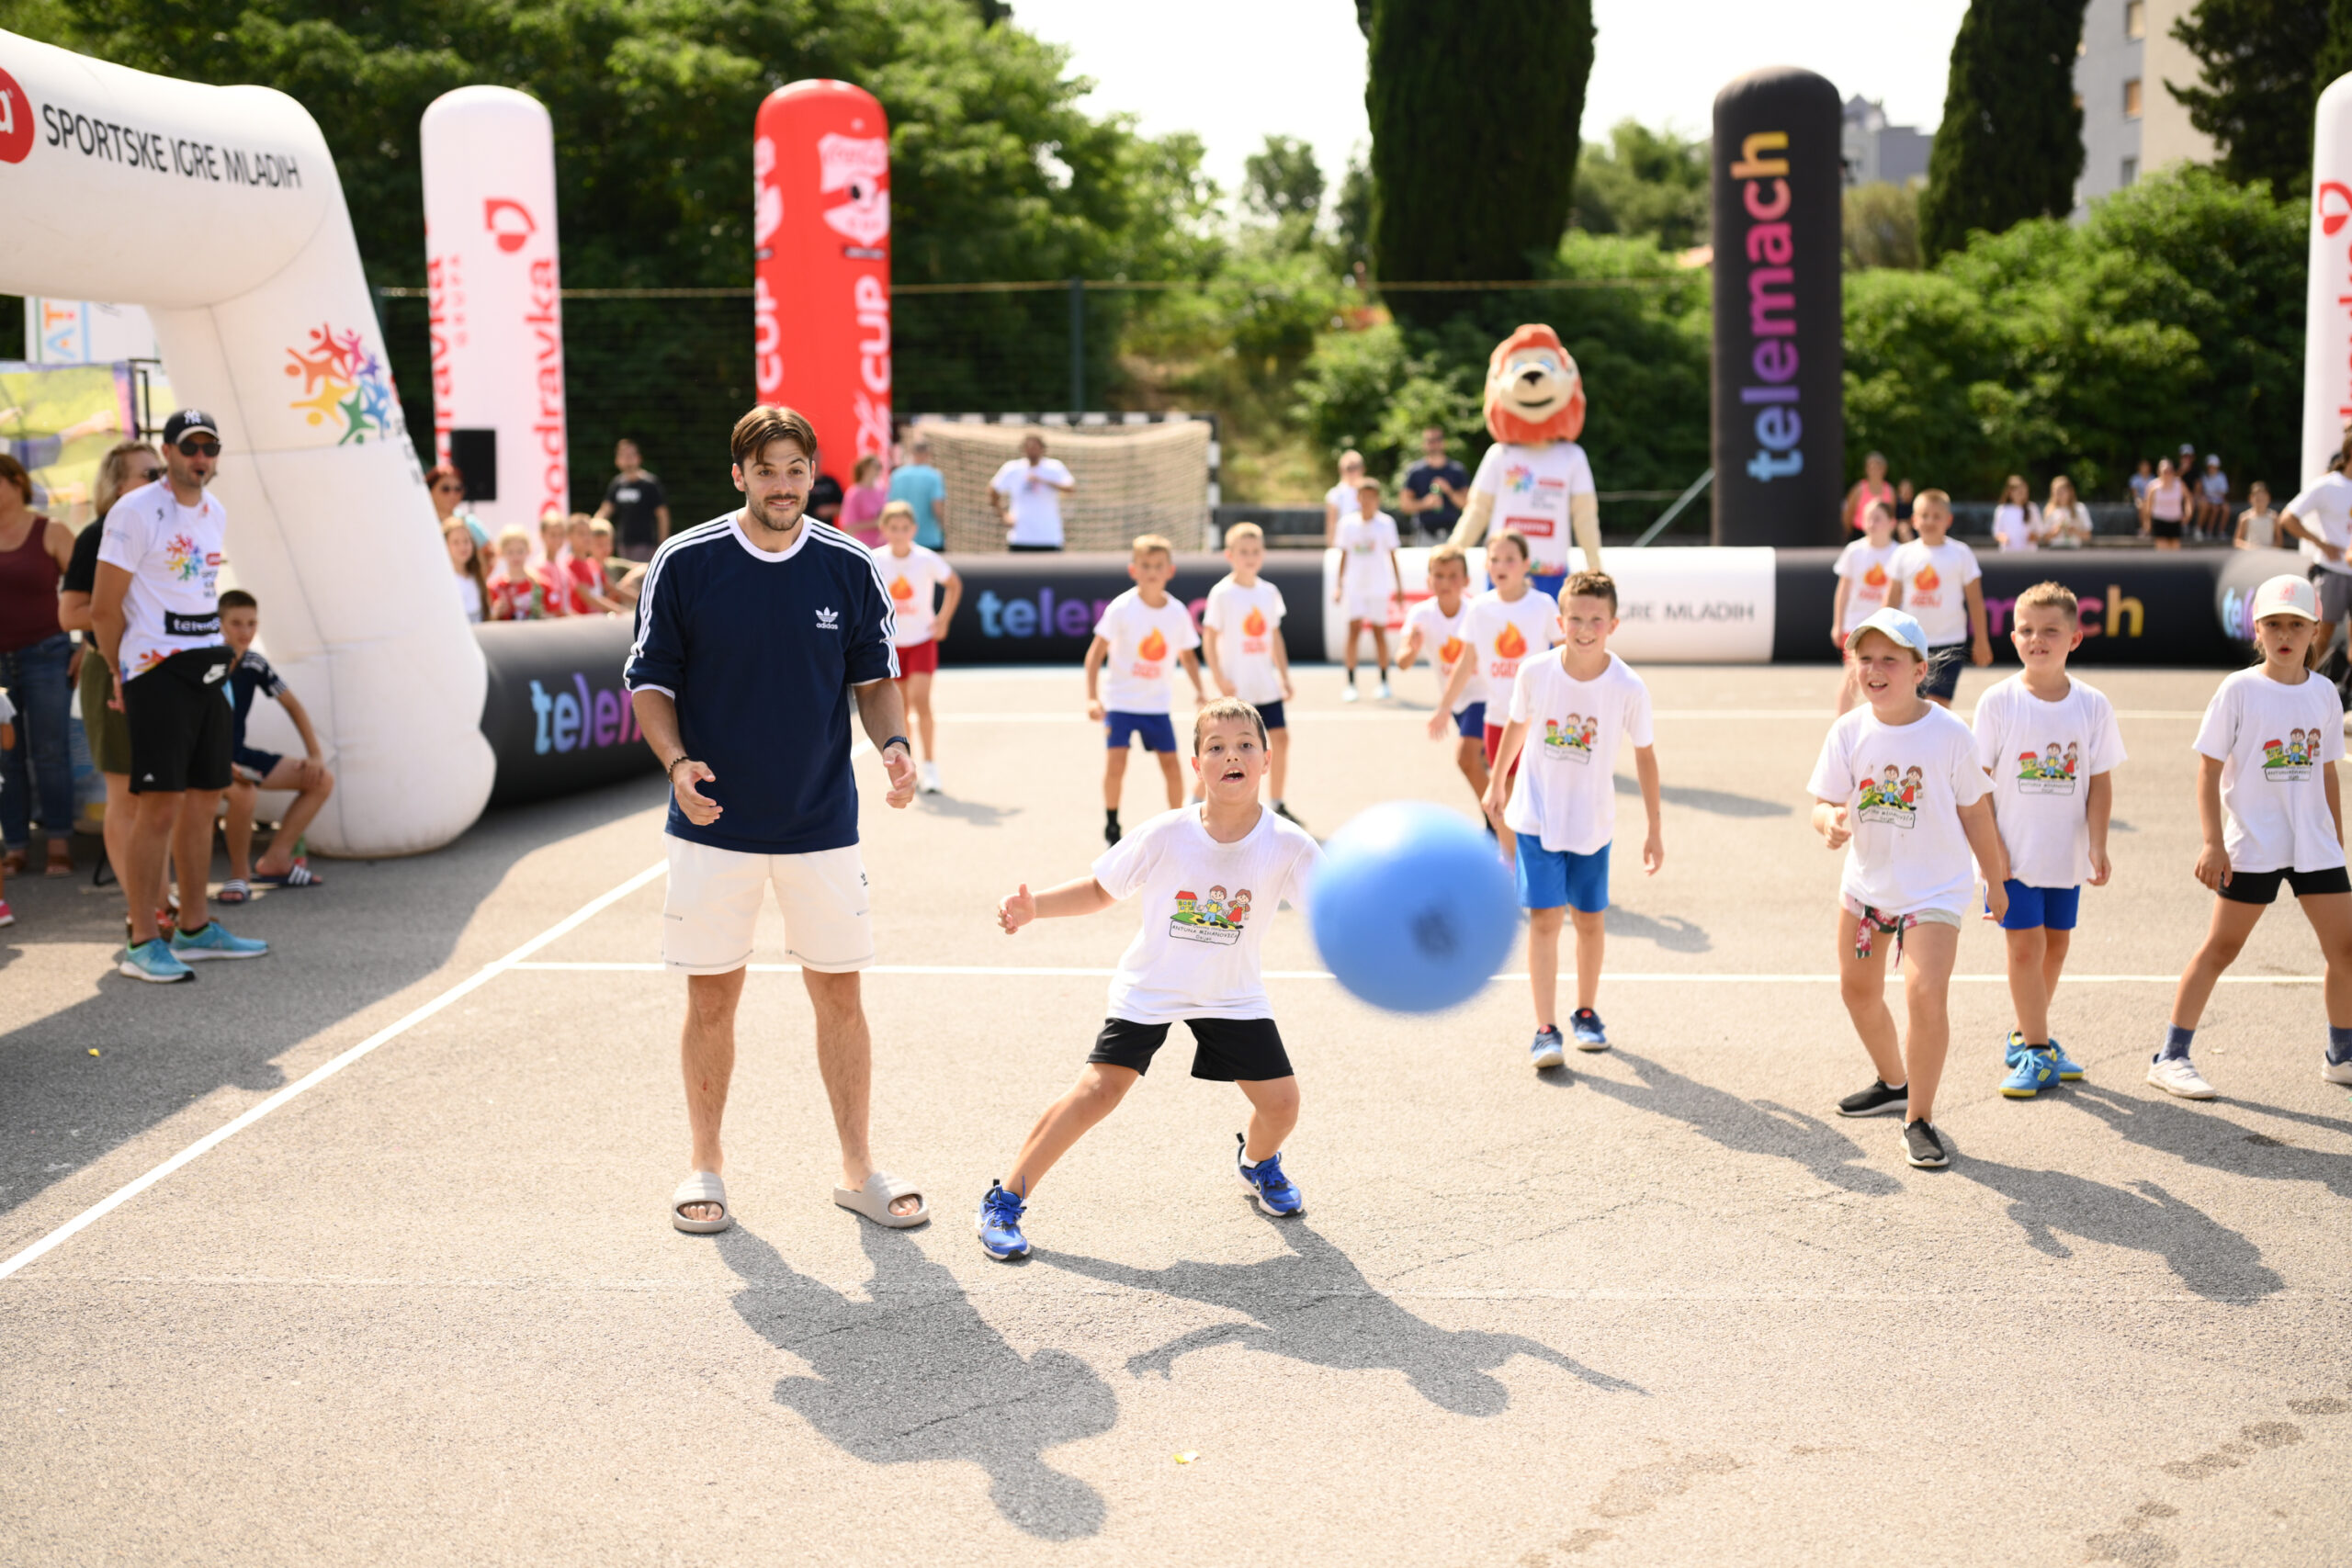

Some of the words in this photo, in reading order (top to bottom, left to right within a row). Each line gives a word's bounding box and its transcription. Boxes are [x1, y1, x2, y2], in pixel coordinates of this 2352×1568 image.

[42, 103, 168, 173] SPORTSKE
[169, 138, 220, 182] IGRE
[221, 147, 302, 189] MLADIH
[854, 275, 891, 393] CUP
[1729, 130, 1804, 482] telemach
[816, 622, 839, 630] adidas
[1665, 602, 1755, 621] MLADIH
[529, 671, 643, 755] tele
